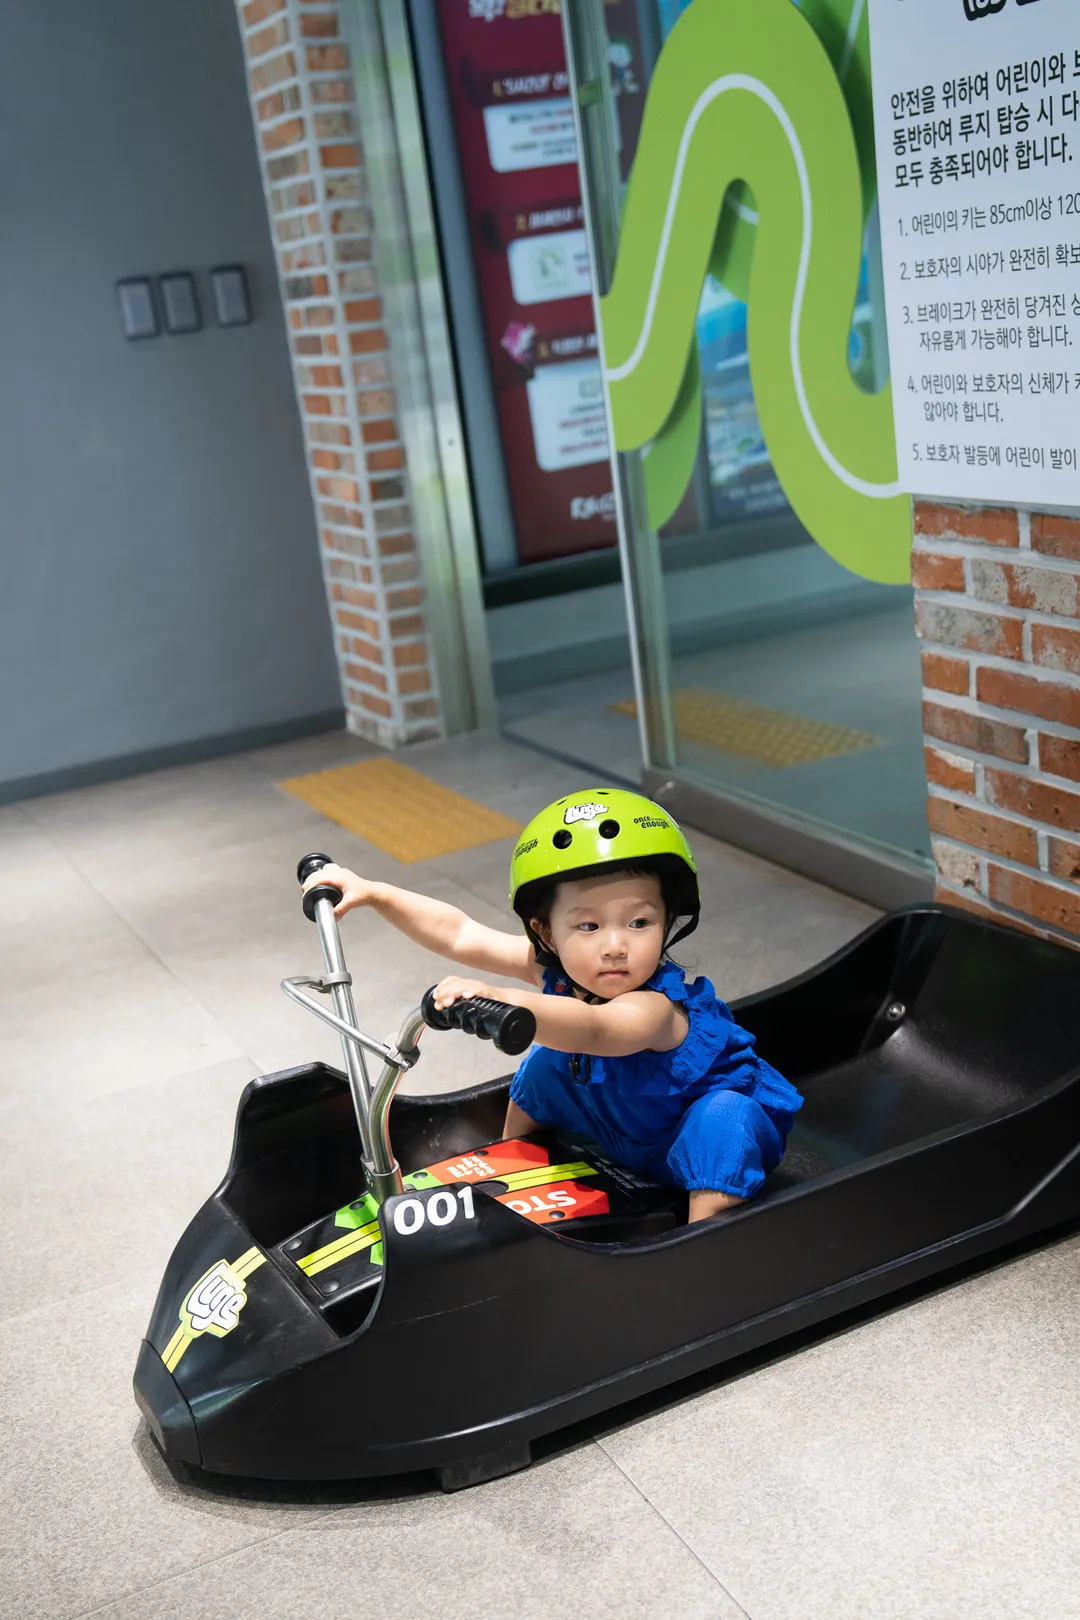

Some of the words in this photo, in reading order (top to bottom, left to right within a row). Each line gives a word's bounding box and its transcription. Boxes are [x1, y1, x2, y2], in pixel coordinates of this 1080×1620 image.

[891, 85, 936, 120] 안전을
[942, 71, 989, 109] 위하여
[996, 52, 1066, 96] 어린이와
[893, 118, 952, 156] 동반하여
[959, 109, 990, 142] 루지
[997, 102, 1031, 136] 탑승
[1036, 95, 1053, 126] 시
[1061, 90, 1080, 122] 다
[895, 161, 924, 188] 모두
[929, 144, 1008, 185] 충족되어야
[1015, 133, 1073, 170] 합니다.
[898, 219, 908, 237] 1.
[912, 209, 958, 236] 어린이의
[961, 206, 987, 230] 키는
[989, 195, 1053, 225] 85cm이상
[900, 262, 911, 281] 2.
[914, 256, 961, 279] 보호자의
[966, 251, 1005, 276] 시야가
[1009, 246, 1050, 272] 완전히
[903, 305, 914, 324] 3.
[917, 300, 976, 323] 브레이크가
[981, 297, 1019, 321] 완전히
[1024, 293, 1066, 319] 당겨진
[919, 330, 966, 352] 자유롭게
[971, 327, 1022, 350] 가능해야
[1027, 324, 1073, 348] 합니다.
[907, 375, 918, 394] 4.
[921, 374, 967, 395] 어린이와
[972, 373, 1023, 394] 보호자의
[1028, 372, 1069, 394] 신체가
[923, 402, 958, 422] 않아야
[962, 401, 1004, 423] 합니다.
[912, 443, 923, 462] 5.
[926, 444, 960, 464] 보호자
[964, 445, 1001, 467] 발등에
[1006, 446, 1045, 468] 어린이
[1050, 448, 1077, 470] 발이
[633, 816, 652, 824] once
[641, 820, 670, 829] enough
[393, 1186, 475, 1236] 001
[505, 1190, 577, 1215] STO
